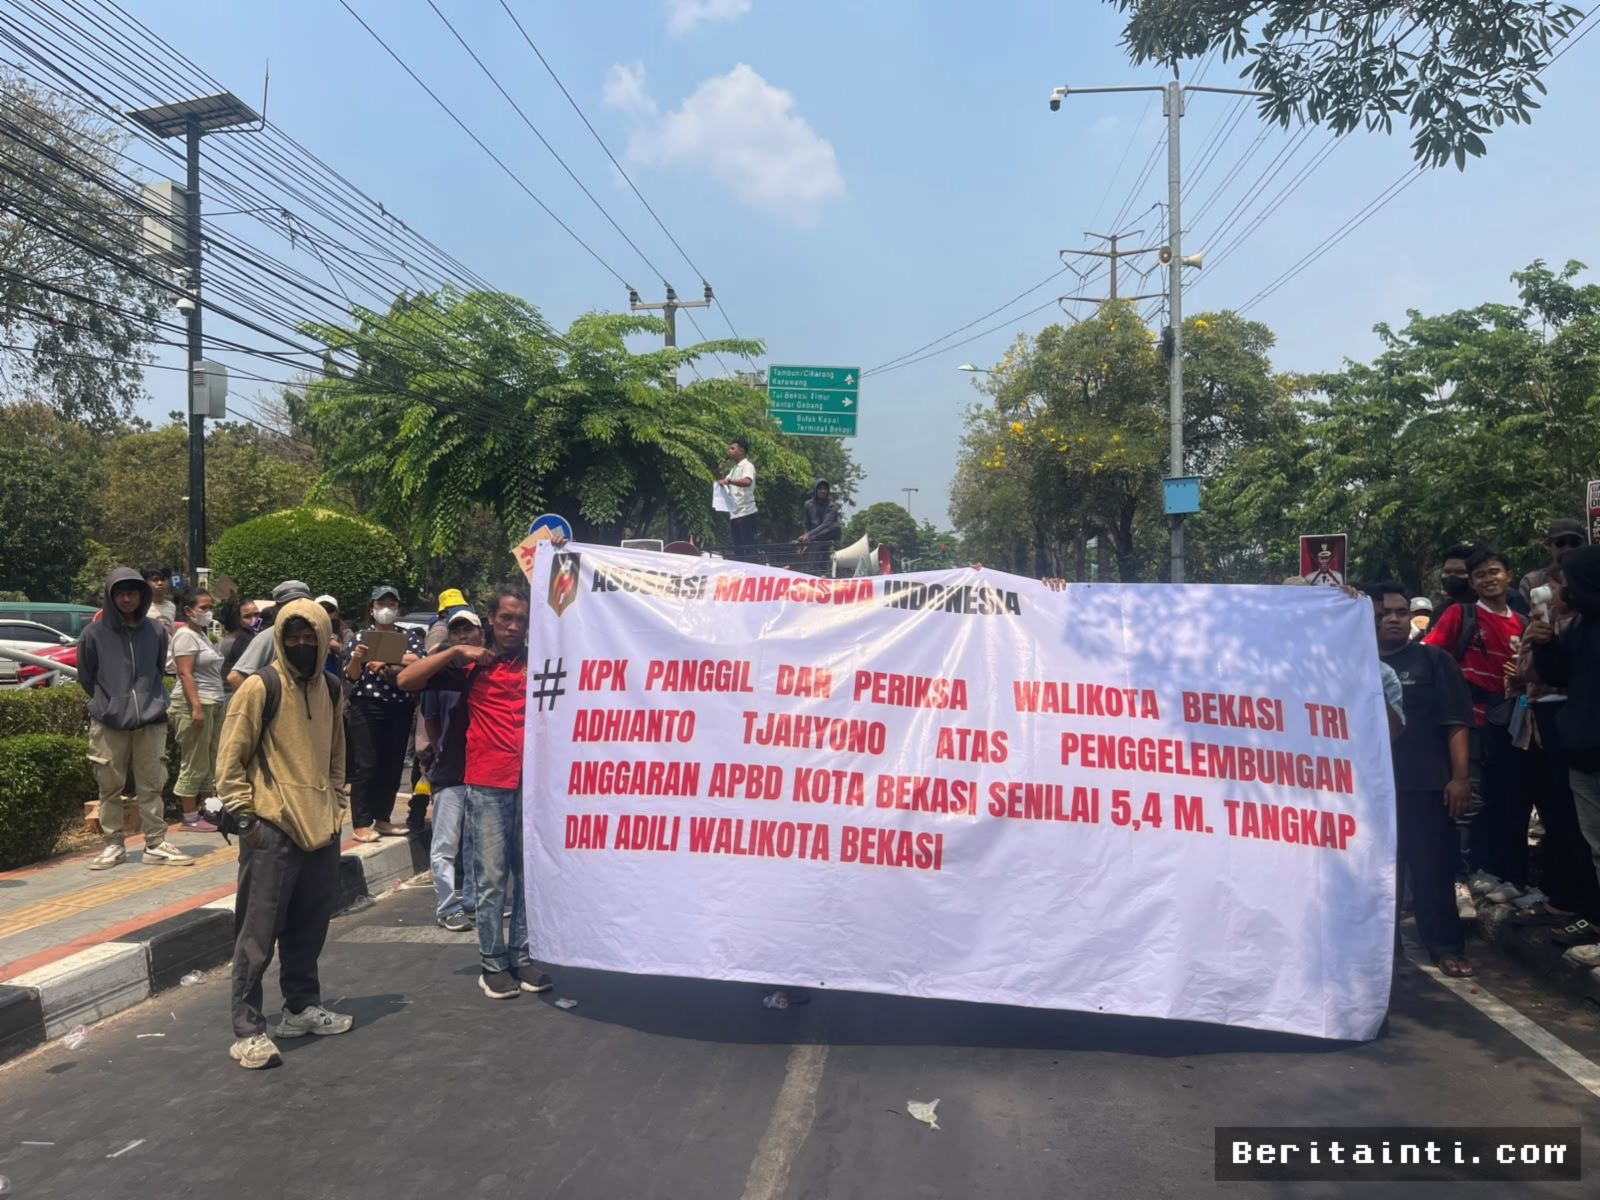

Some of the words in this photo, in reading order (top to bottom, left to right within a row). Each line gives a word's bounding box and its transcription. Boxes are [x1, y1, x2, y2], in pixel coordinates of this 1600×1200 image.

[772, 378, 807, 387] Karawang
[796, 402, 823, 410] Gebang
[713, 575, 874, 606] MAHASISWA
[884, 580, 1022, 615] INDONESIA
[578, 659, 628, 691] KPK
[645, 660, 754, 693] PANGGIL
[776, 665, 832, 698] DAN
[853, 670, 968, 711] PERIKSA
[1013, 681, 1160, 721] WALIKOTA
[1182, 691, 1284, 732] BEKASI
[1304, 702, 1349, 740] TRI
[572, 709, 696, 743] ADHIANTO
[742, 711, 886, 755] TJAHYONO
[936, 727, 1008, 763] ATAS
[1061, 732, 1354, 795] PENGGELEMBUNGAN
[568, 761, 700, 797] ANGGARAN
[708, 763, 783, 800] APBD
[793, 767, 864, 807] KOTA
[876, 774, 977, 816] BEKASI
[988, 782, 1099, 824] SENILAI
[1111, 789, 1163, 832] 5,4
[1173, 794, 1214, 834] M.
[1223, 800, 1356, 851] TANGKAP
[564, 815, 607, 850] DAN
[614, 815, 681, 852] ADILI
[689, 816, 830, 861] WALIKOTA
[840, 827, 944, 871] BEKASI
